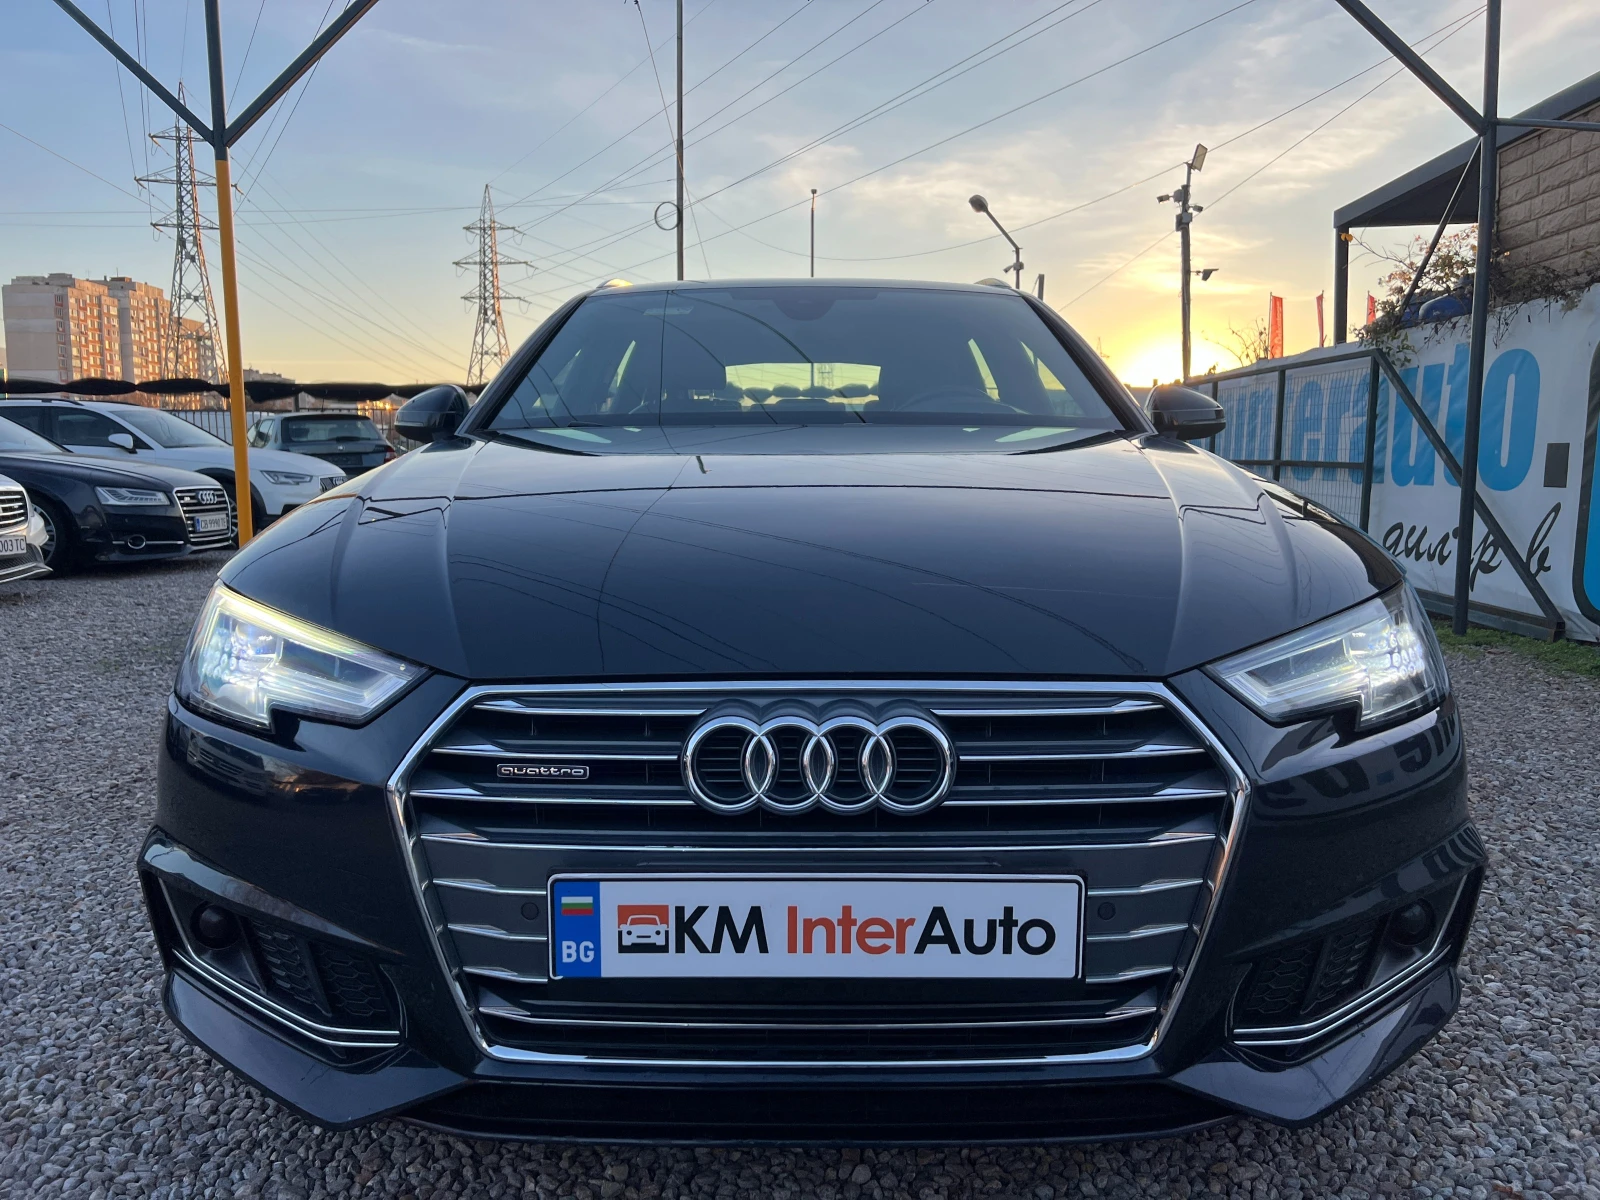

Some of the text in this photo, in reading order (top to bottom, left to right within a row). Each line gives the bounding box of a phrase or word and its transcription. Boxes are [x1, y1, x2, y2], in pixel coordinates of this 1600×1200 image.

[15, 538, 25, 551] TC
[501, 766, 585, 776] quattro
[674, 904, 1057, 956] KM InterAuto
[561, 940, 595, 963] BG
